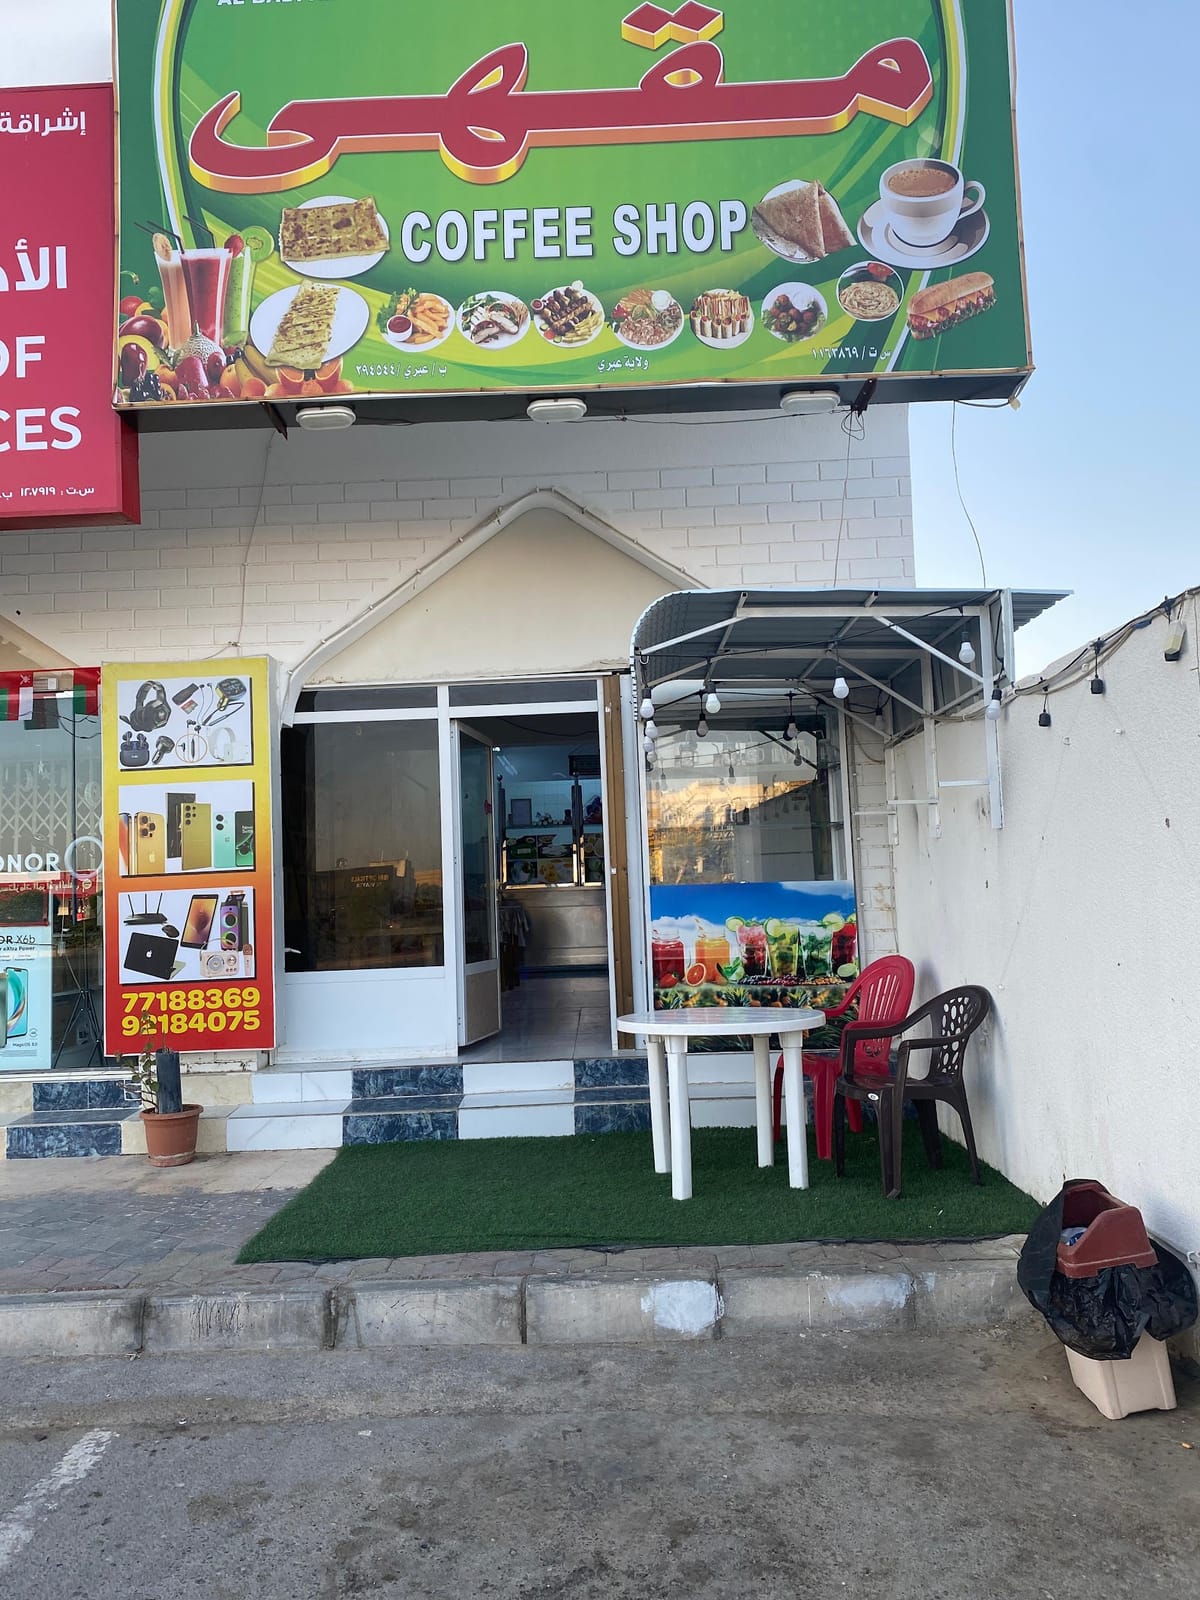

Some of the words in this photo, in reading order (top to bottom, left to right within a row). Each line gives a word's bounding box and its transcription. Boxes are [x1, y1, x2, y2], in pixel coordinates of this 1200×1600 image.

[189, 1, 934, 194] مقهى
[0, 107, 87, 137] إشراقة
[400, 204, 595, 264] COFFEE
[612, 199, 749, 257] SHOP
[0, 335, 46, 378] F
[597, 359, 622, 373] عبري
[624, 354, 649, 371] ولاية
[404, 365, 429, 379] عبري
[0, 852, 60, 873] NOR
[121, 986, 261, 1014] 77188369
[121, 1009, 261, 1036] 92184075
